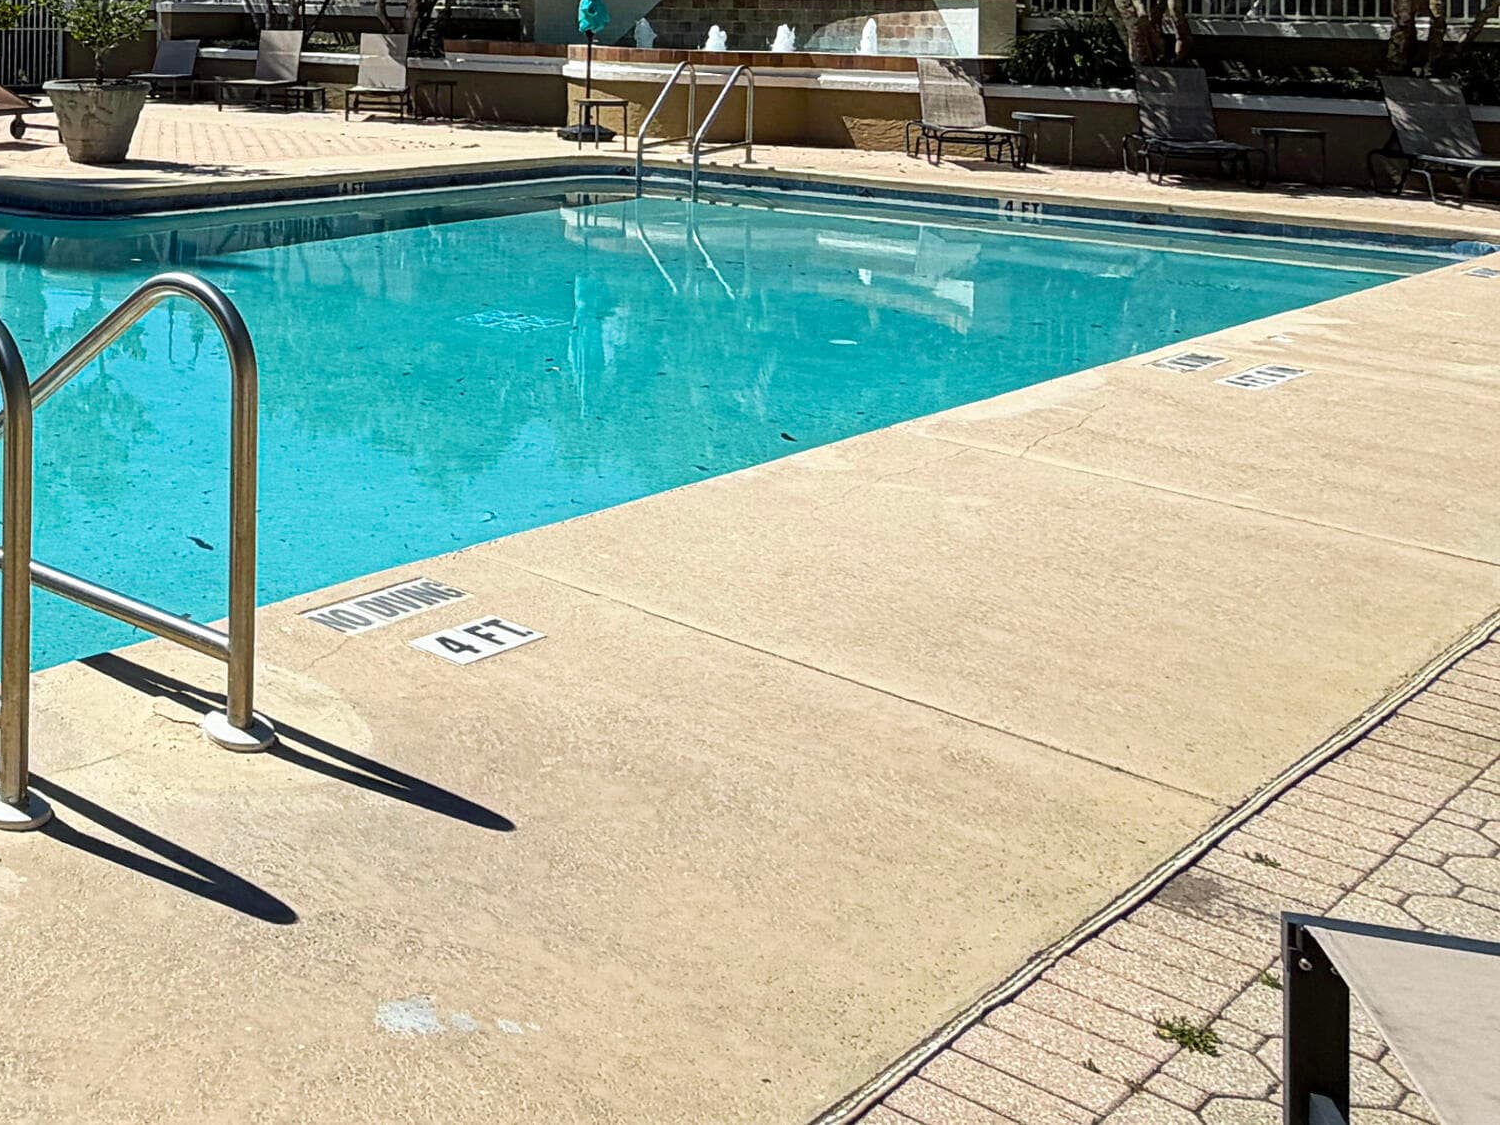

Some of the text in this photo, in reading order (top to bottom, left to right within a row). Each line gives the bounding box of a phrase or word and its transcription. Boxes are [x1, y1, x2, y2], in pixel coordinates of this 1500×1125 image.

[1003, 200, 1041, 214] 4 FT
[307, 580, 467, 634] NO DIVING
[435, 618, 535, 654] 4 FT.
